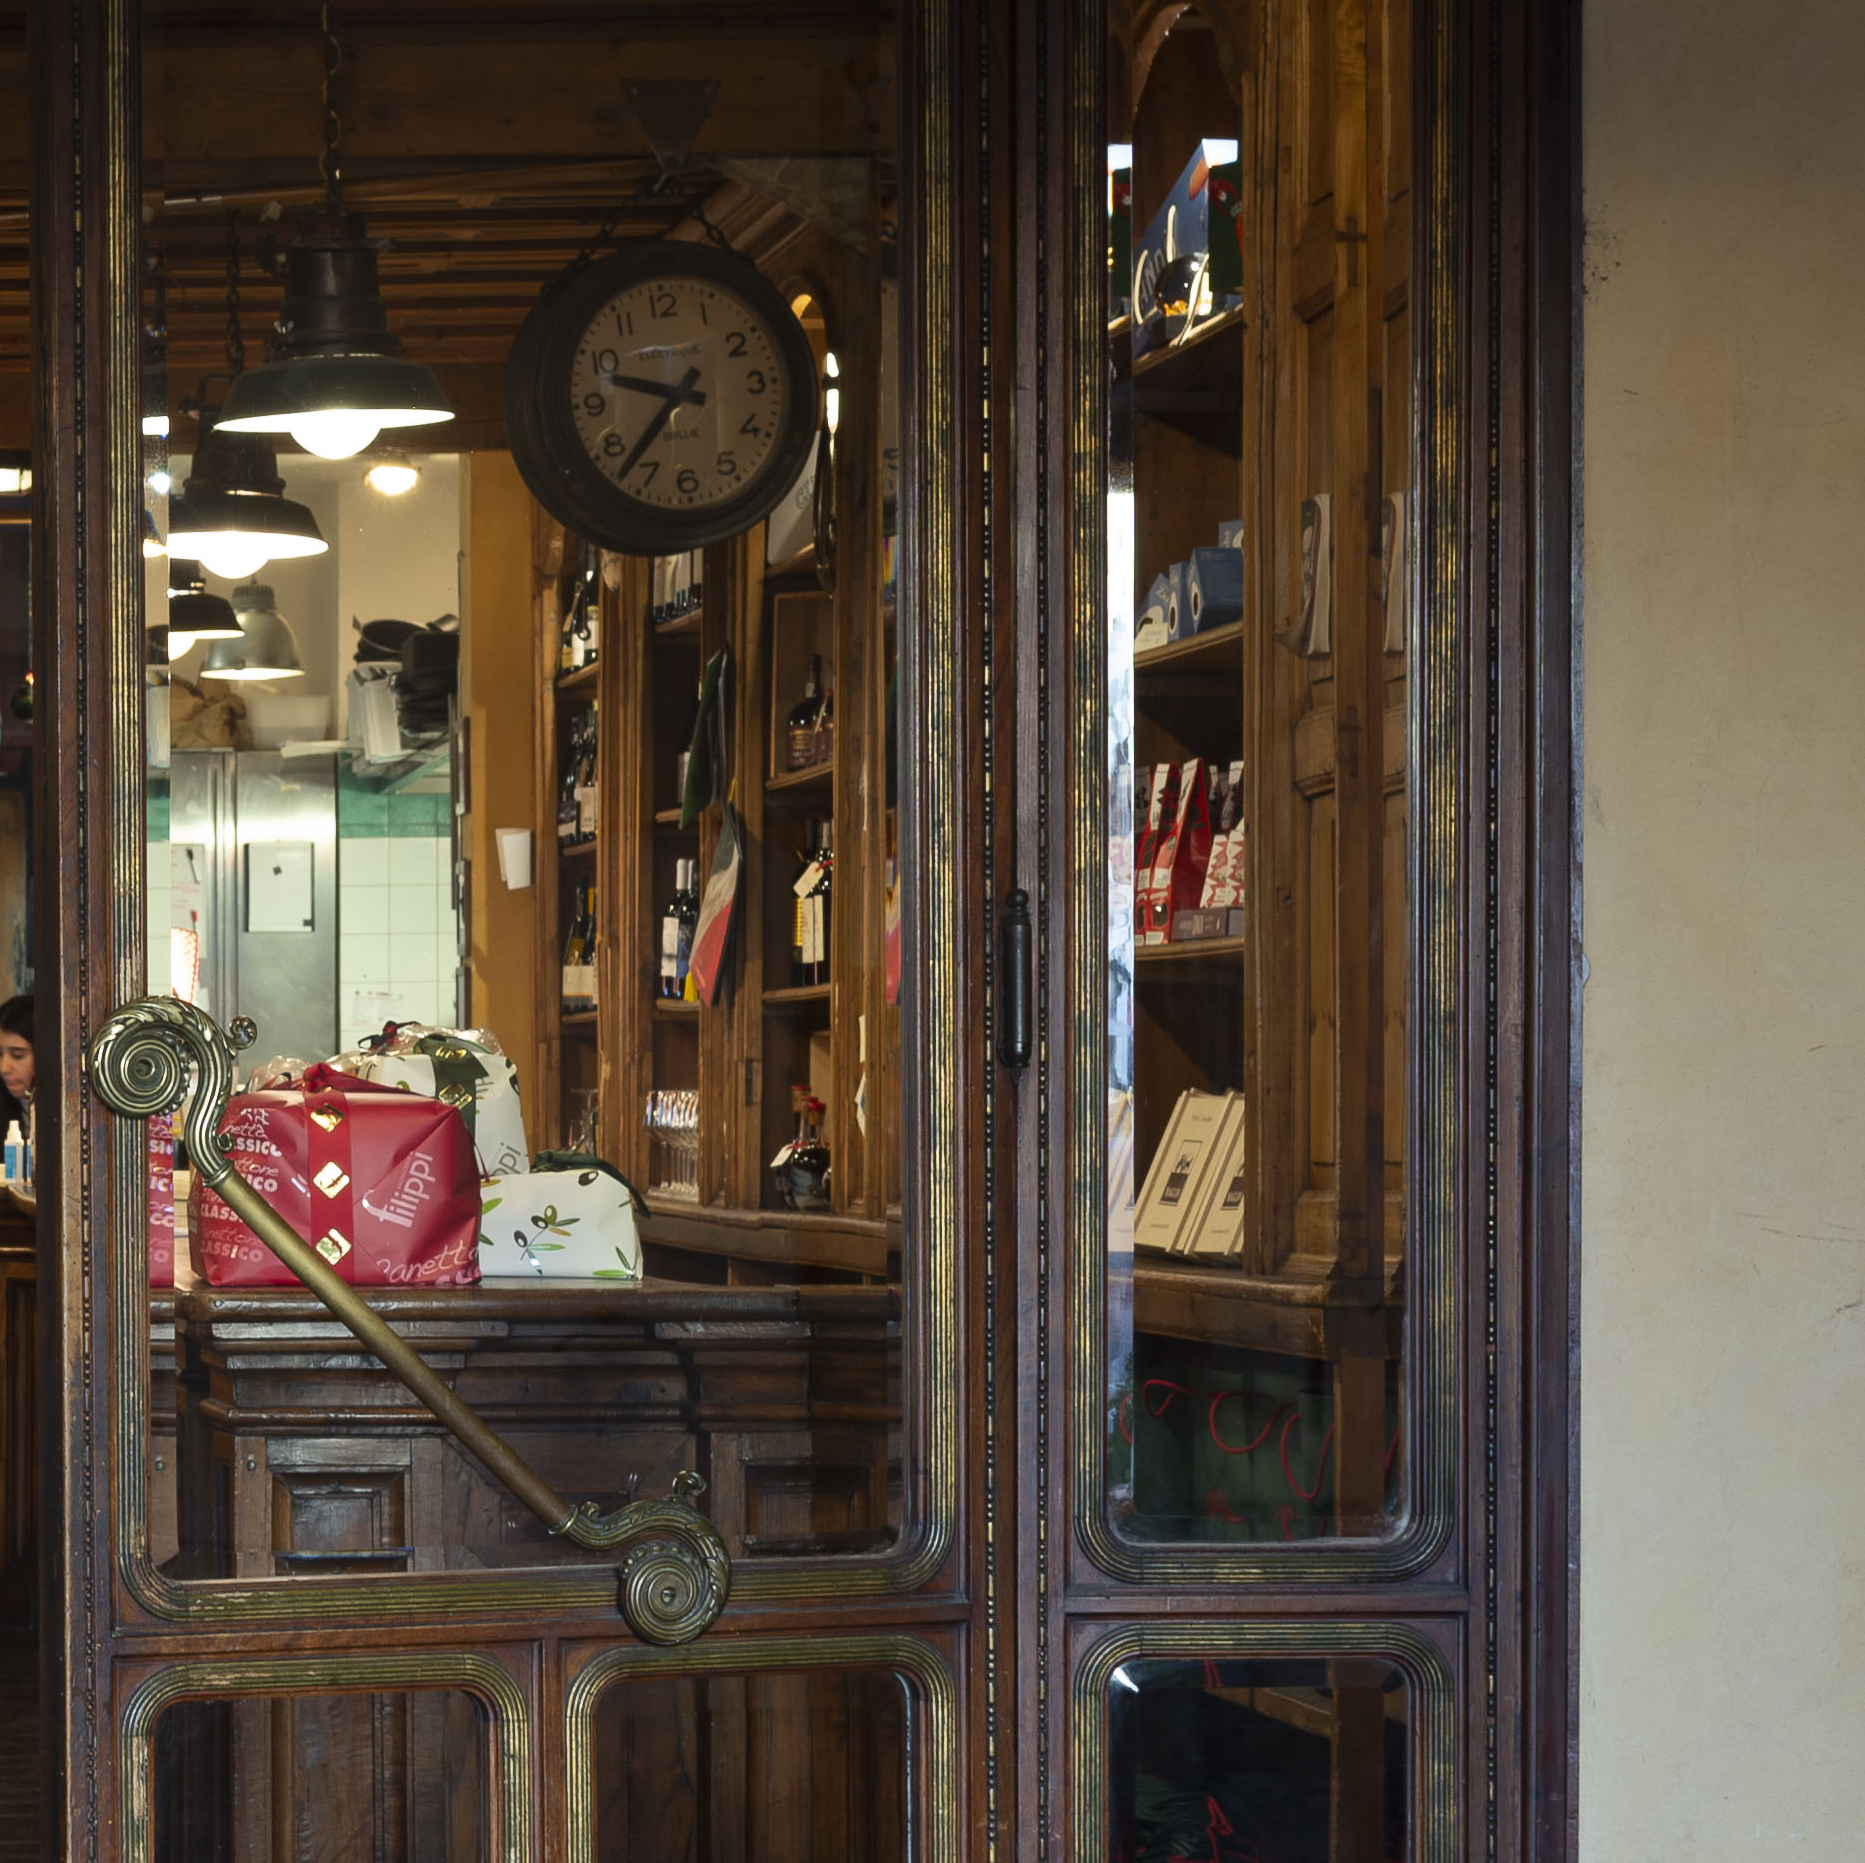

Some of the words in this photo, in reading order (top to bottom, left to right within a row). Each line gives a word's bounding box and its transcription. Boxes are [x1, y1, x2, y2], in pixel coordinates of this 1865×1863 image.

[648, 293, 680, 319] 12
[700, 301, 709, 326] 1
[616, 311, 634, 337] 11
[725, 331, 748, 358] 2
[591, 348, 620, 376] 10
[745, 369, 767, 395] 3
[582, 391, 606, 417] 9
[738, 412, 762, 438] 4
[602, 432, 626, 458] 8
[638, 461, 661, 488] 7
[716, 450, 738, 476] 5
[675, 469, 700, 494] 6
[361, 1151, 436, 1228] filippi
